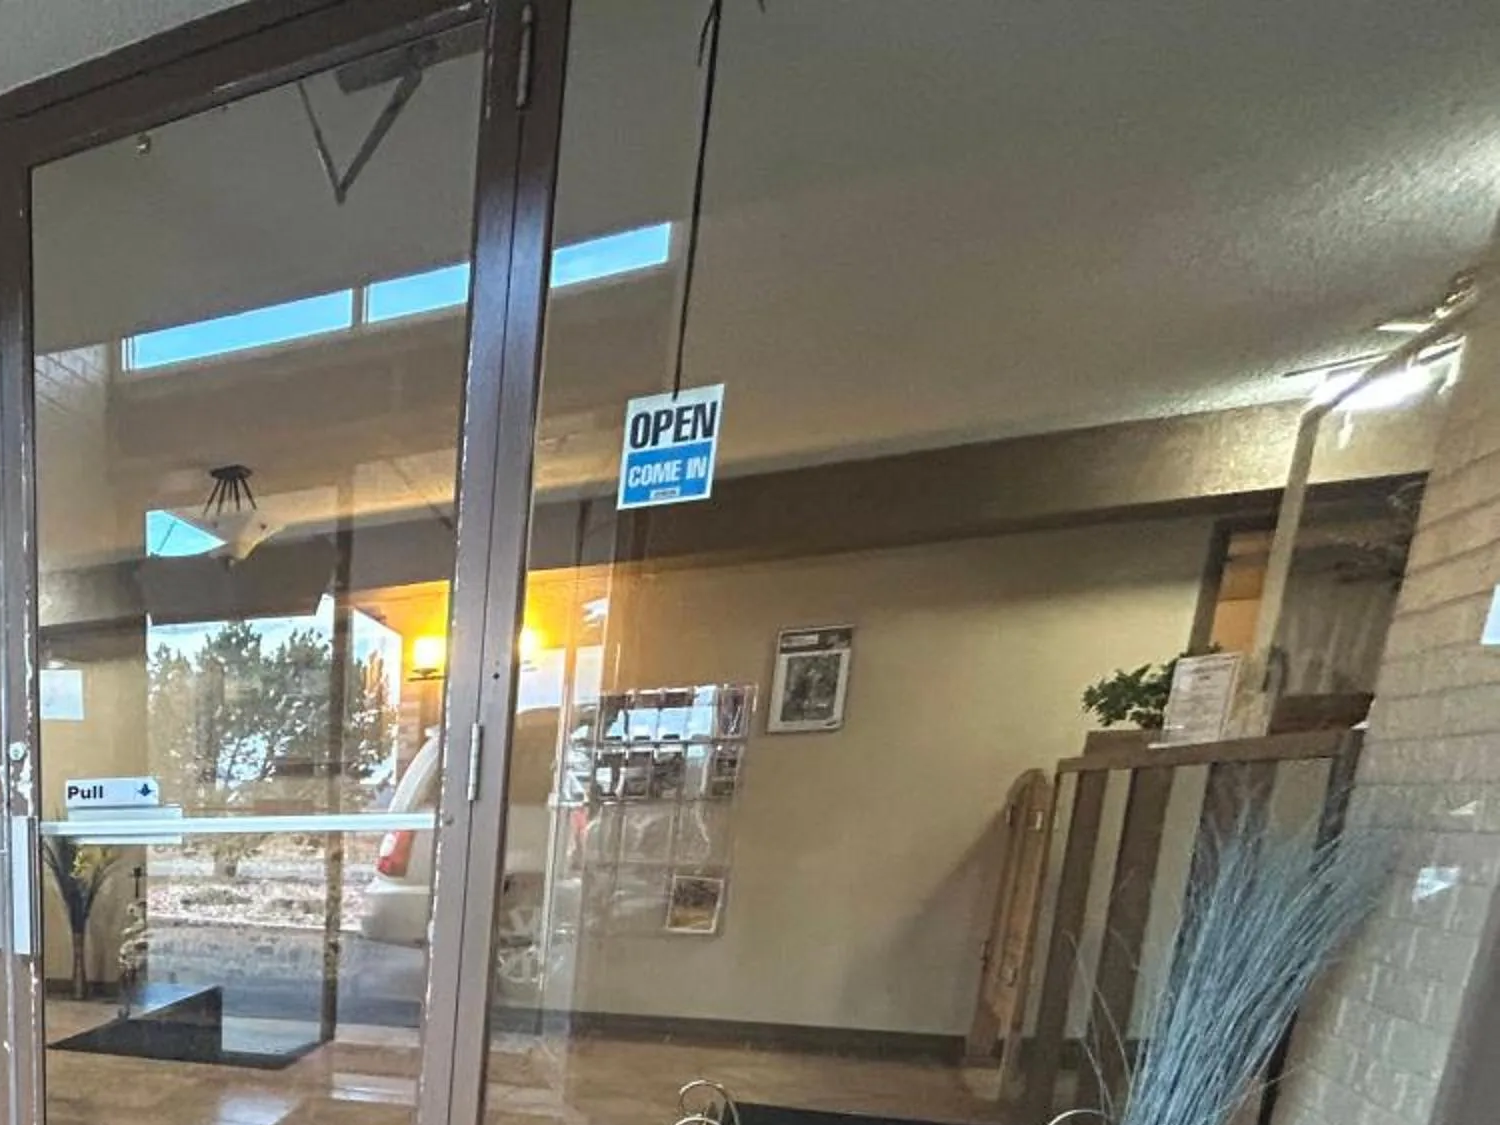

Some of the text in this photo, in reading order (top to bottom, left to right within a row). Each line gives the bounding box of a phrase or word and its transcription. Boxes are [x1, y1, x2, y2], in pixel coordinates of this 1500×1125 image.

[630, 401, 718, 449] OPEN
[627, 456, 708, 488] COME IN
[67, 785, 103, 800] Pull
